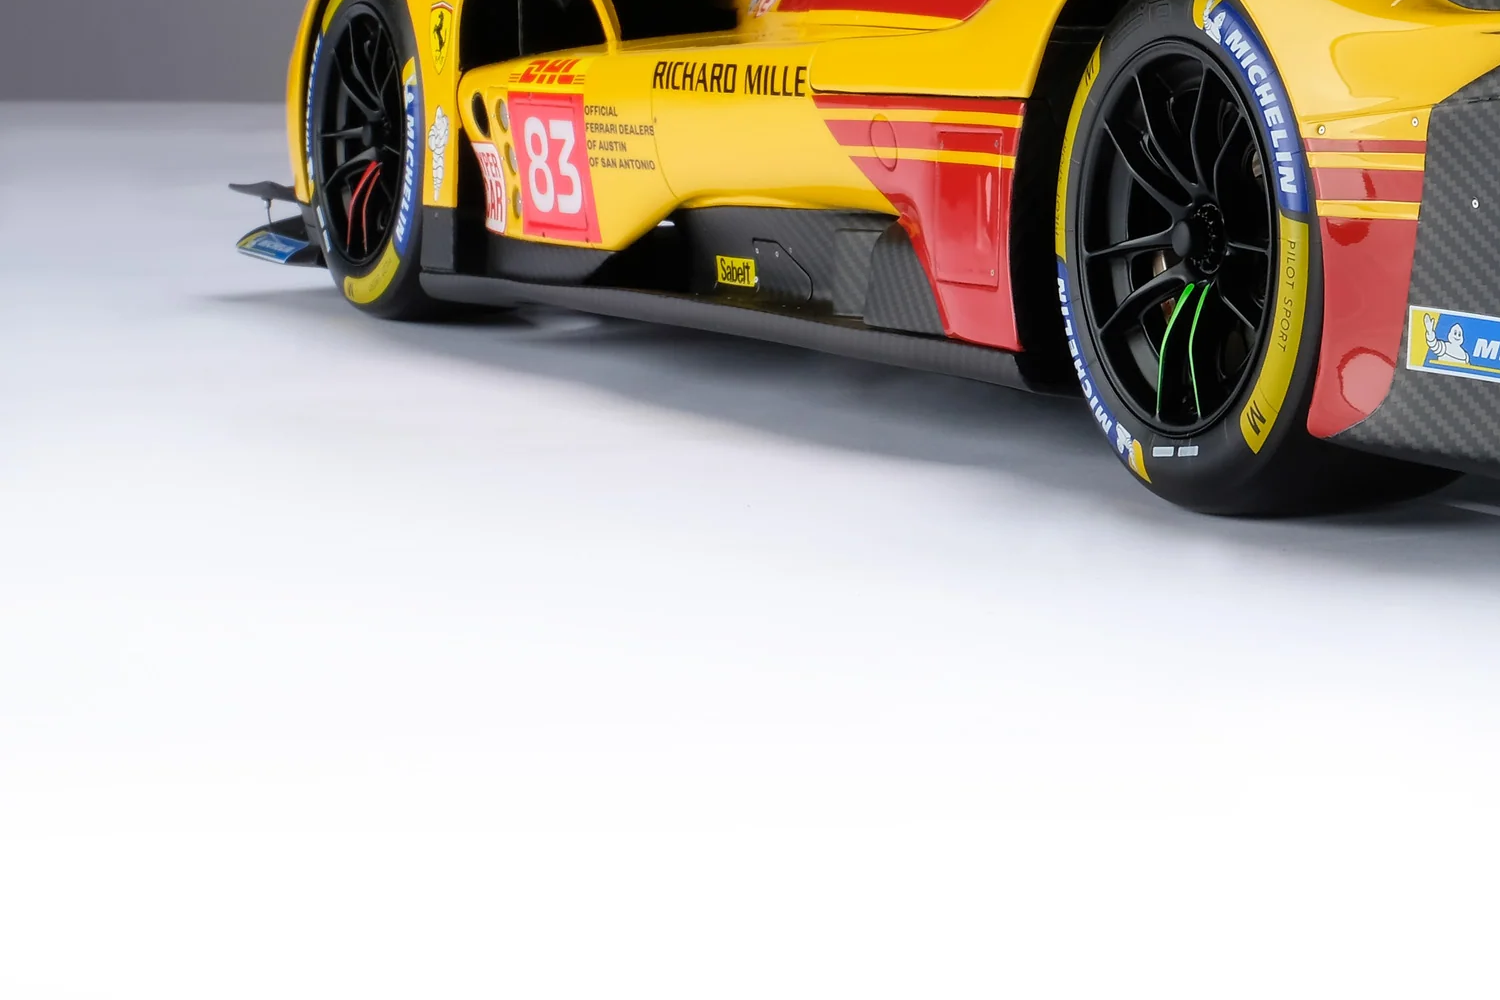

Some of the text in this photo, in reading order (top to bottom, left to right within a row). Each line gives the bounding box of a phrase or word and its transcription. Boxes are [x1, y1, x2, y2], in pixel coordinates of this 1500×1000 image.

[518, 59, 582, 84] DHL
[652, 61, 807, 97] RICHARD MILLE
[584, 105, 618, 117] OFFICIAL
[1225, 29, 1298, 194] MICHELIN
[585, 122, 655, 136] FERRARI DEALERS
[587, 140, 627, 152] OF AUSTIN
[395, 114, 415, 243] MICHELIN
[524, 116, 583, 214] 83
[589, 157, 656, 170] OF SAN ANTONIO
[720, 257, 750, 285] Sabelt
[1277, 239, 1296, 352] PILOT SPORT
[1057, 277, 1113, 435] MICHELIN
[1246, 400, 1266, 435] M
